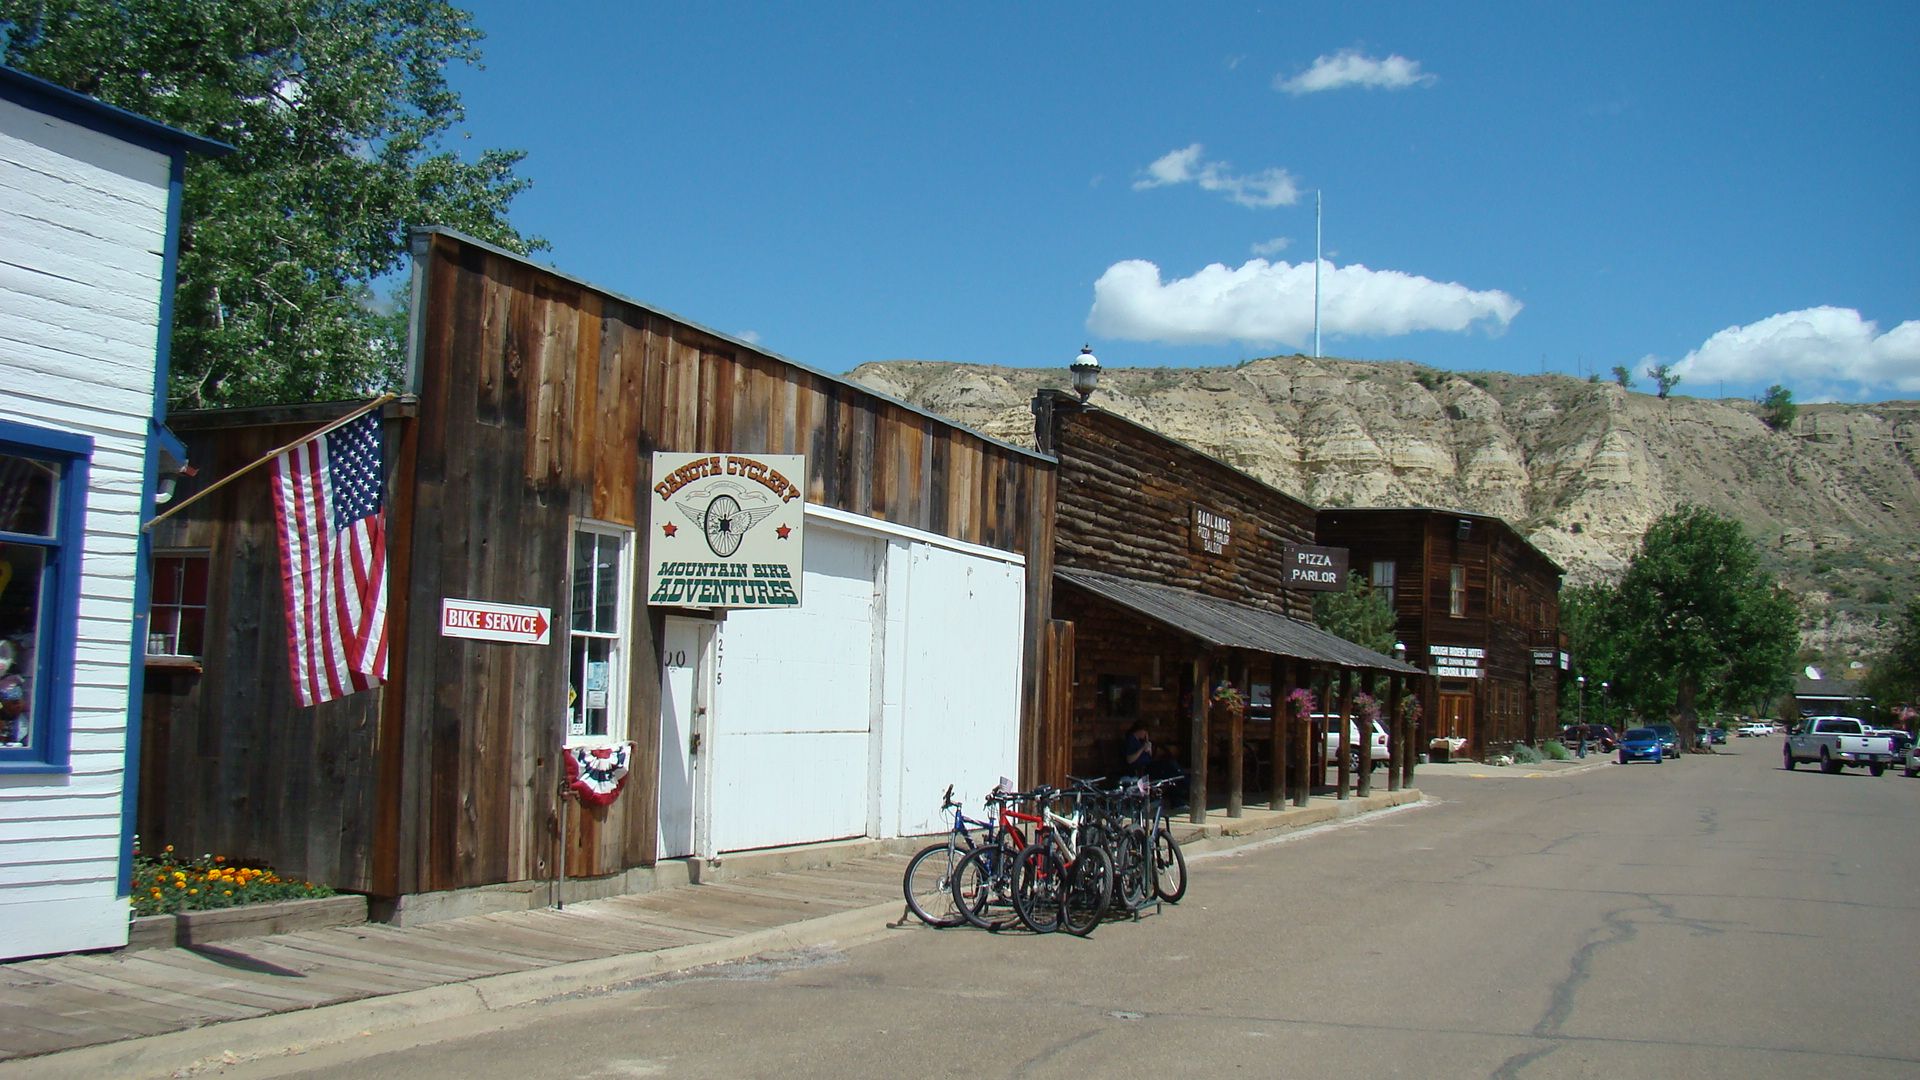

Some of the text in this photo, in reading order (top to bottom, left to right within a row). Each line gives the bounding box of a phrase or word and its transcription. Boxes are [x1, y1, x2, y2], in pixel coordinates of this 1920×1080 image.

[653, 455, 801, 504] DAKOTA CYCLERY
[1197, 510, 1231, 534] BADLANDS
[657, 562, 792, 579] MOUNTAIN BIKE
[1297, 552, 1332, 567] PIZZA
[1292, 568, 1337, 584] PARLOR
[650, 578, 799, 605] ADVENTURES
[448, 609, 538, 633] BIKE SERVICE
